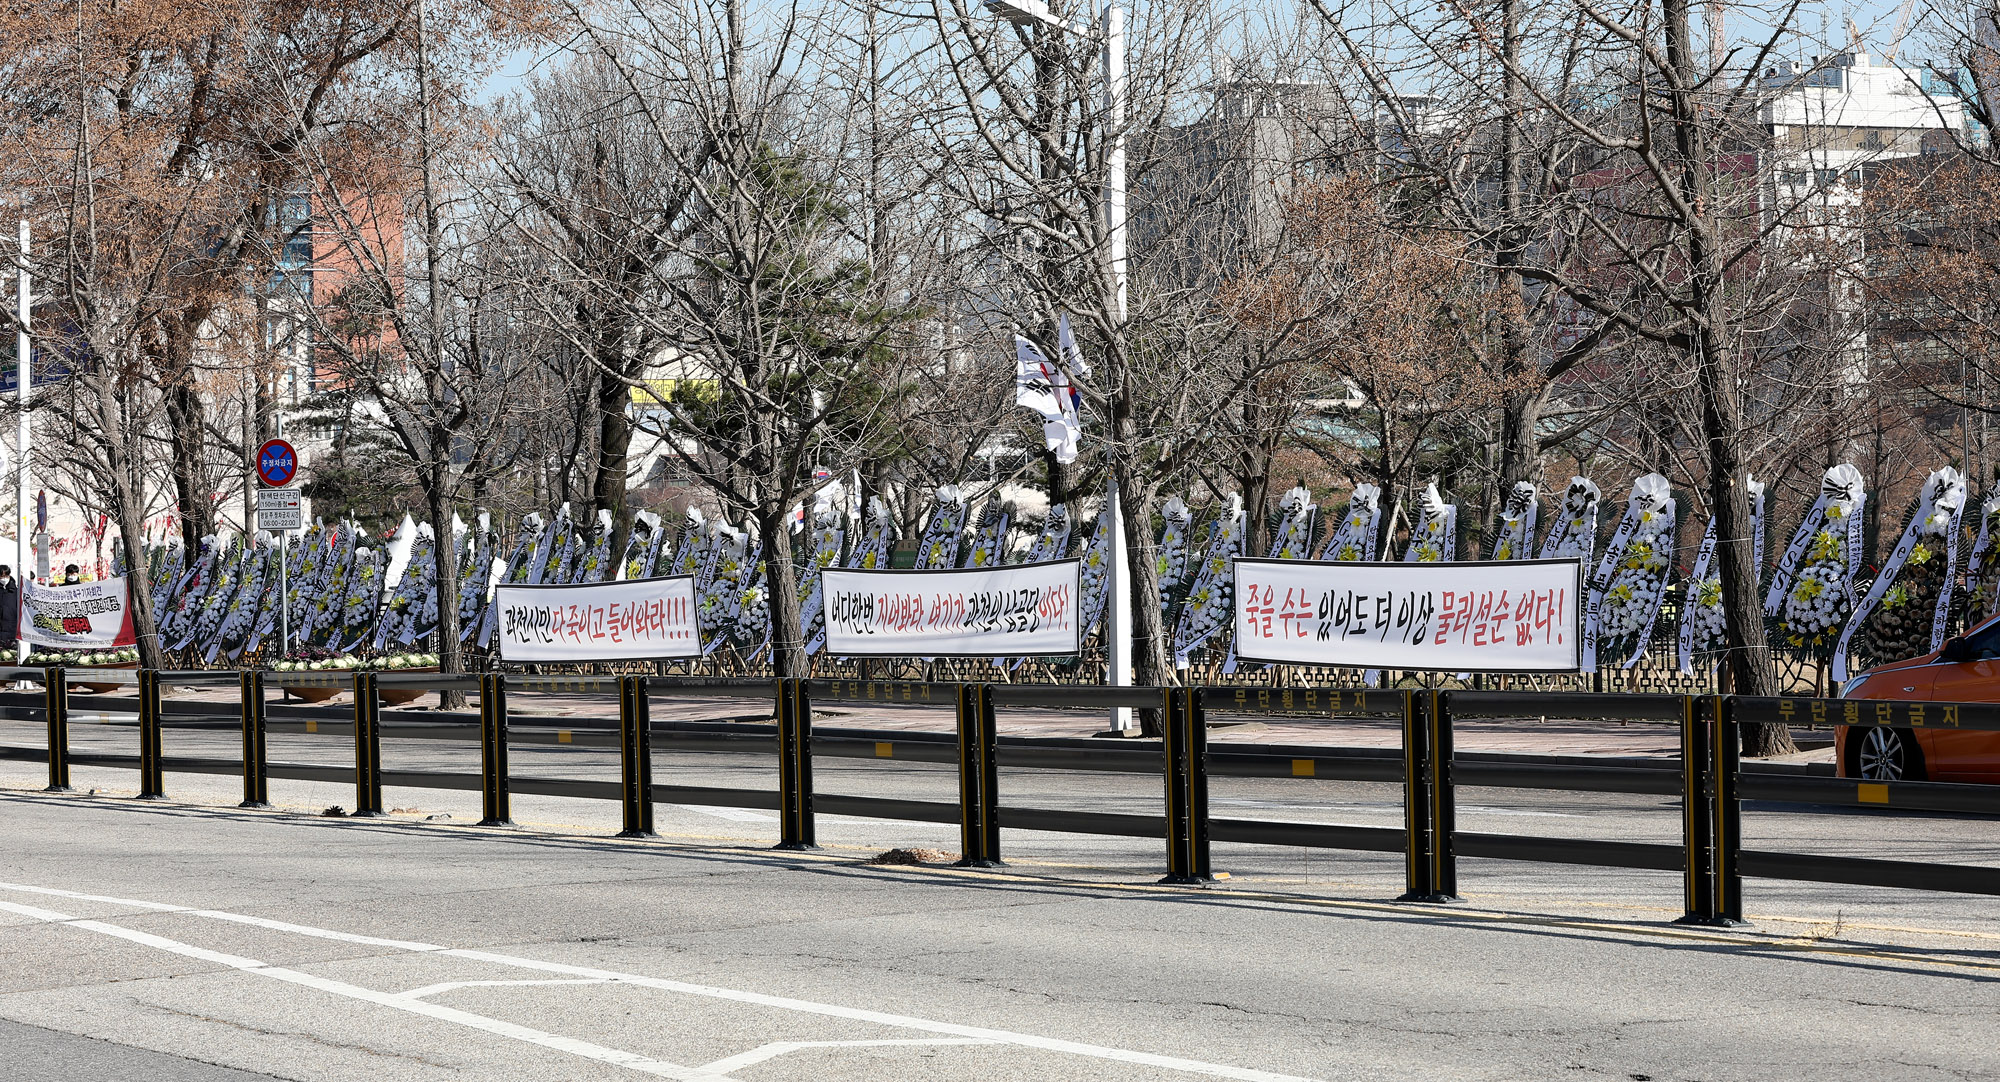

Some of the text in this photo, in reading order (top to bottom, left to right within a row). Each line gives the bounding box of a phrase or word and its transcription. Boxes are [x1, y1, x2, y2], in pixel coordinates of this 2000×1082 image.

[261, 458, 293, 467] 주정차금지
[22, 516, 27, 526] 1
[1324, 520, 1352, 560] GZ
[1947, 513, 1960, 550] 법무부
[916, 519, 942, 569] GZSS
[1773, 507, 1822, 591] GZSS
[505, 604, 553, 644] 과천시민
[606, 596, 689, 644] 들어와라!!!
[927, 592, 966, 634] 여기가
[1245, 584, 1275, 639] 죽을
[1279, 587, 1313, 640] 수는
[1316, 589, 1369, 642] 있어도
[1375, 590, 1393, 643] 더
[1397, 590, 1435, 646] 이상
[1514, 587, 1565, 647] 없다!
[831, 681, 930, 700] 무단횡단금지
[1234, 689, 1367, 710] 무단횡단금지
[1778, 699, 1960, 727] 무단횡단금지
